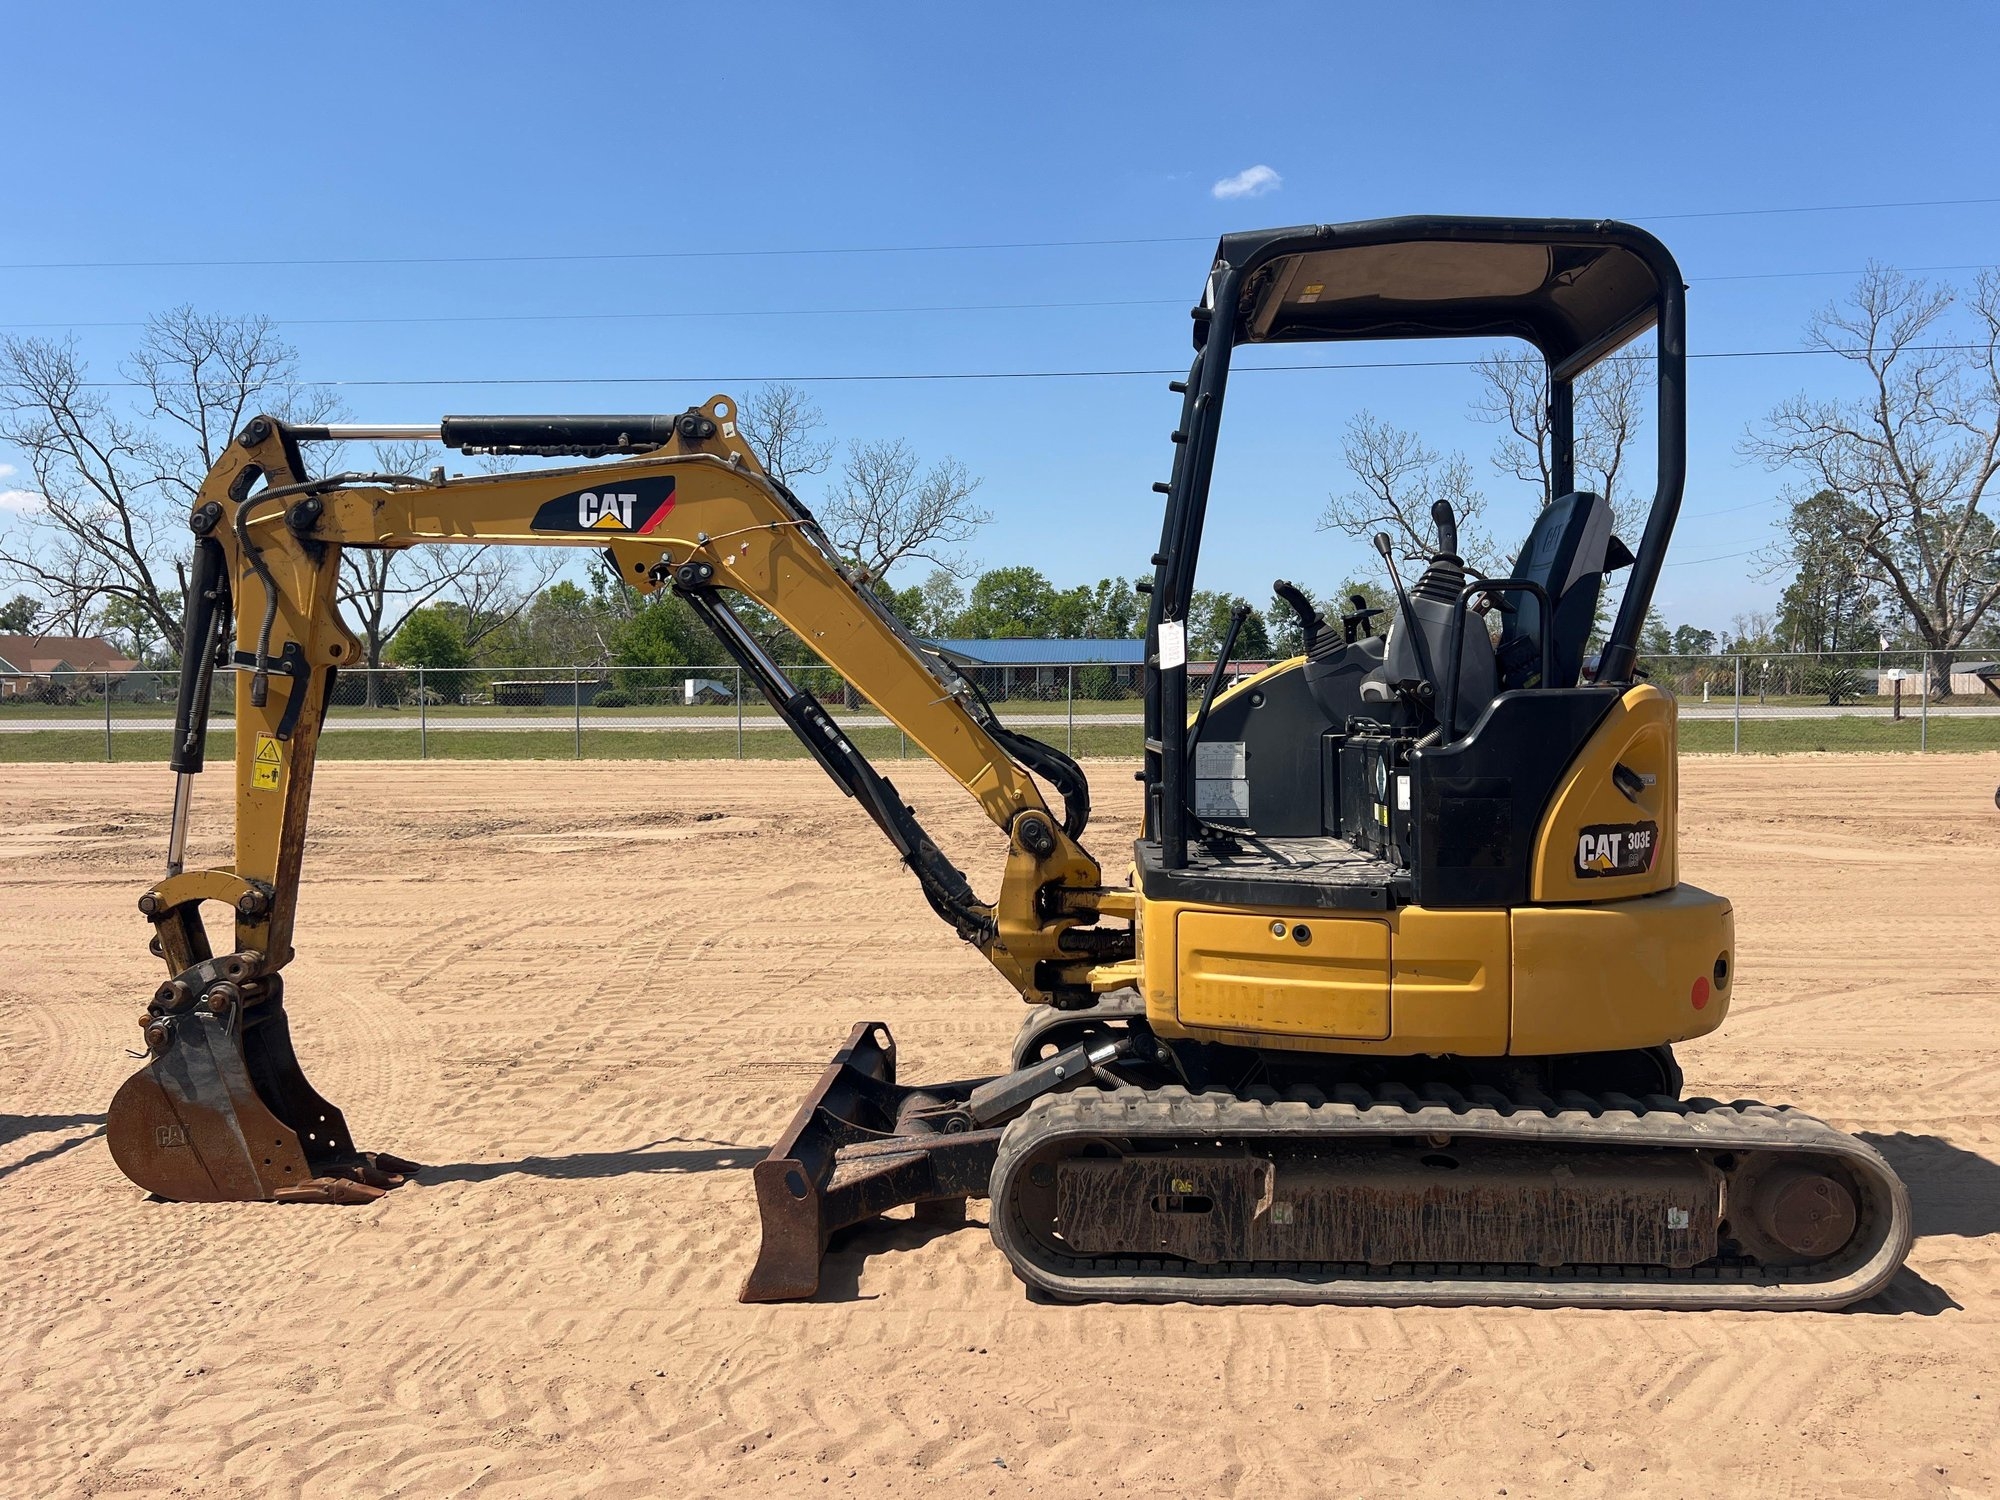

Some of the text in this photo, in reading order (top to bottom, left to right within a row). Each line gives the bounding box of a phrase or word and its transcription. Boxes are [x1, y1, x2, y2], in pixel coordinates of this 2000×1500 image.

[579, 492, 637, 529] CAT
[1579, 830, 1651, 870] CAT 303E
